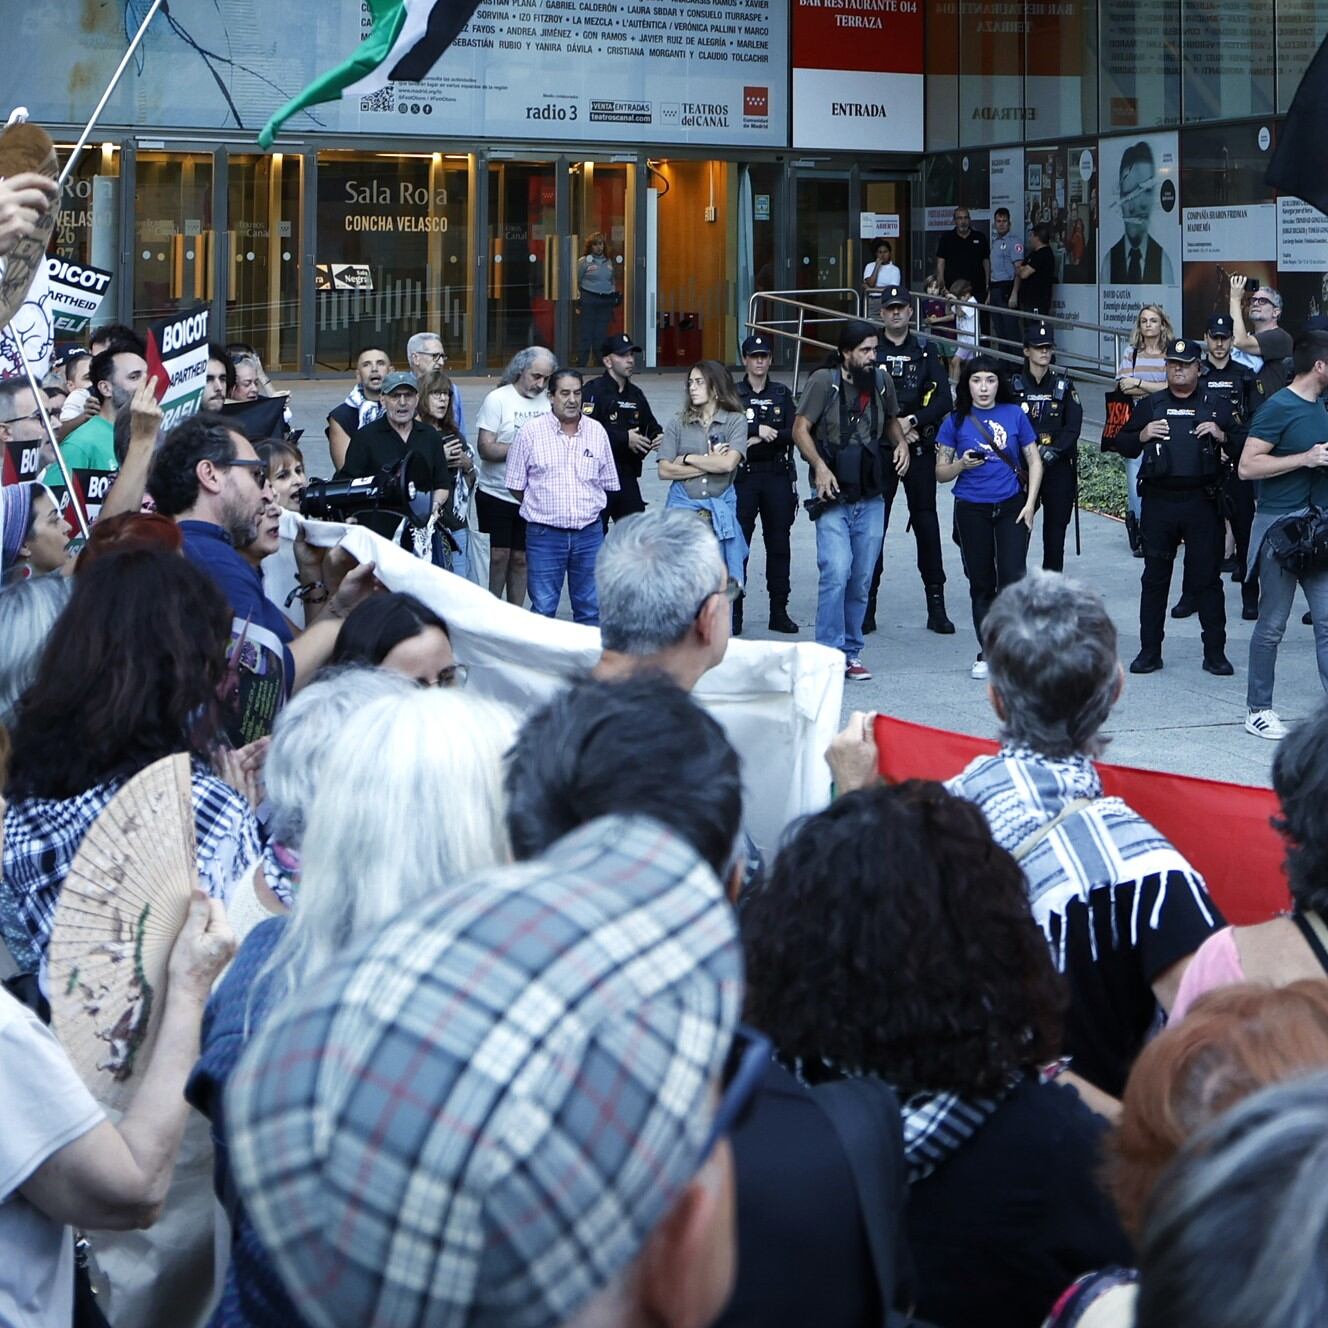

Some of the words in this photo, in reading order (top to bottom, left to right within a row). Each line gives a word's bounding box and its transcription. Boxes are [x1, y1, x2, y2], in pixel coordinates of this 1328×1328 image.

[546, 0, 576, 10] GABRIEL
[579, 2, 617, 12] CALDERÓN
[628, 6, 650, 14] LAURA
[654, 7, 677, 16] SBDAR
[680, 8, 684, 16] Y
[687, 9, 722, 19] CONSUELO
[725, 11, 762, 22] ITURRASPE
[745, 0, 768, 8] XAVIER
[477, 10, 509, 20] SORVINA
[520, 12, 531, 21] IZO
[534, 14, 562, 23] FITZROY
[573, 16, 581, 24] LA
[584, 17, 613, 26] MEZCLA
[675, 21, 708, 32] VERÓNICA
[710, 25, 736, 34] PALLINI
[738, 26, 742, 34] Y
[745, 27, 768, 36] MARCO
[835, 15, 882, 29] TERRAZA
[472, 24, 495, 34] FAYOS
[507, 28, 536, 36] ANDREA
[540, 28, 571, 38] JIMÉNEZ
[583, 31, 597, 39] GON
[601, 32, 627, 41] RAMOS
[639, 34, 663, 43] JAVIER
[667, 35, 682, 44] RUIZ
[686, 37, 695, 45] DE
[698, 37, 726, 47] ALEGRÍA
[737, 40, 768, 50] MARLENE
[499, 40, 522, 49] RUBIO
[526, 42, 530, 50] Y
[535, 43, 562, 52] YANIRA
[567, 42, 592, 53] DÁVILA
[607, 46, 645, 56] CRISTIANA
[649, 49, 686, 59] MORGANTI
[690, 51, 694, 59] Y
[699, 51, 728, 61] CLAUDIO
[732, 53, 768, 63] TOLCACHIR
[526, 105, 566, 121] radio
[569, 105, 578, 121] 3
[592, 102, 613, 112] VENTA
[615, 104, 650, 113] ENTRADAS
[682, 103, 729, 115] TEATROS
[832, 103, 886, 118] ENTRADA
[591, 113, 651, 123] teatroscanal.com
[345, 180, 391, 204] Sala
[345, 216, 393, 231] CONCHA
[397, 216, 448, 232] VELASCO
[48, 259, 110, 291] OICOT
[162, 311, 208, 353] BOICOT
[170, 358, 208, 386] APARTHEID
